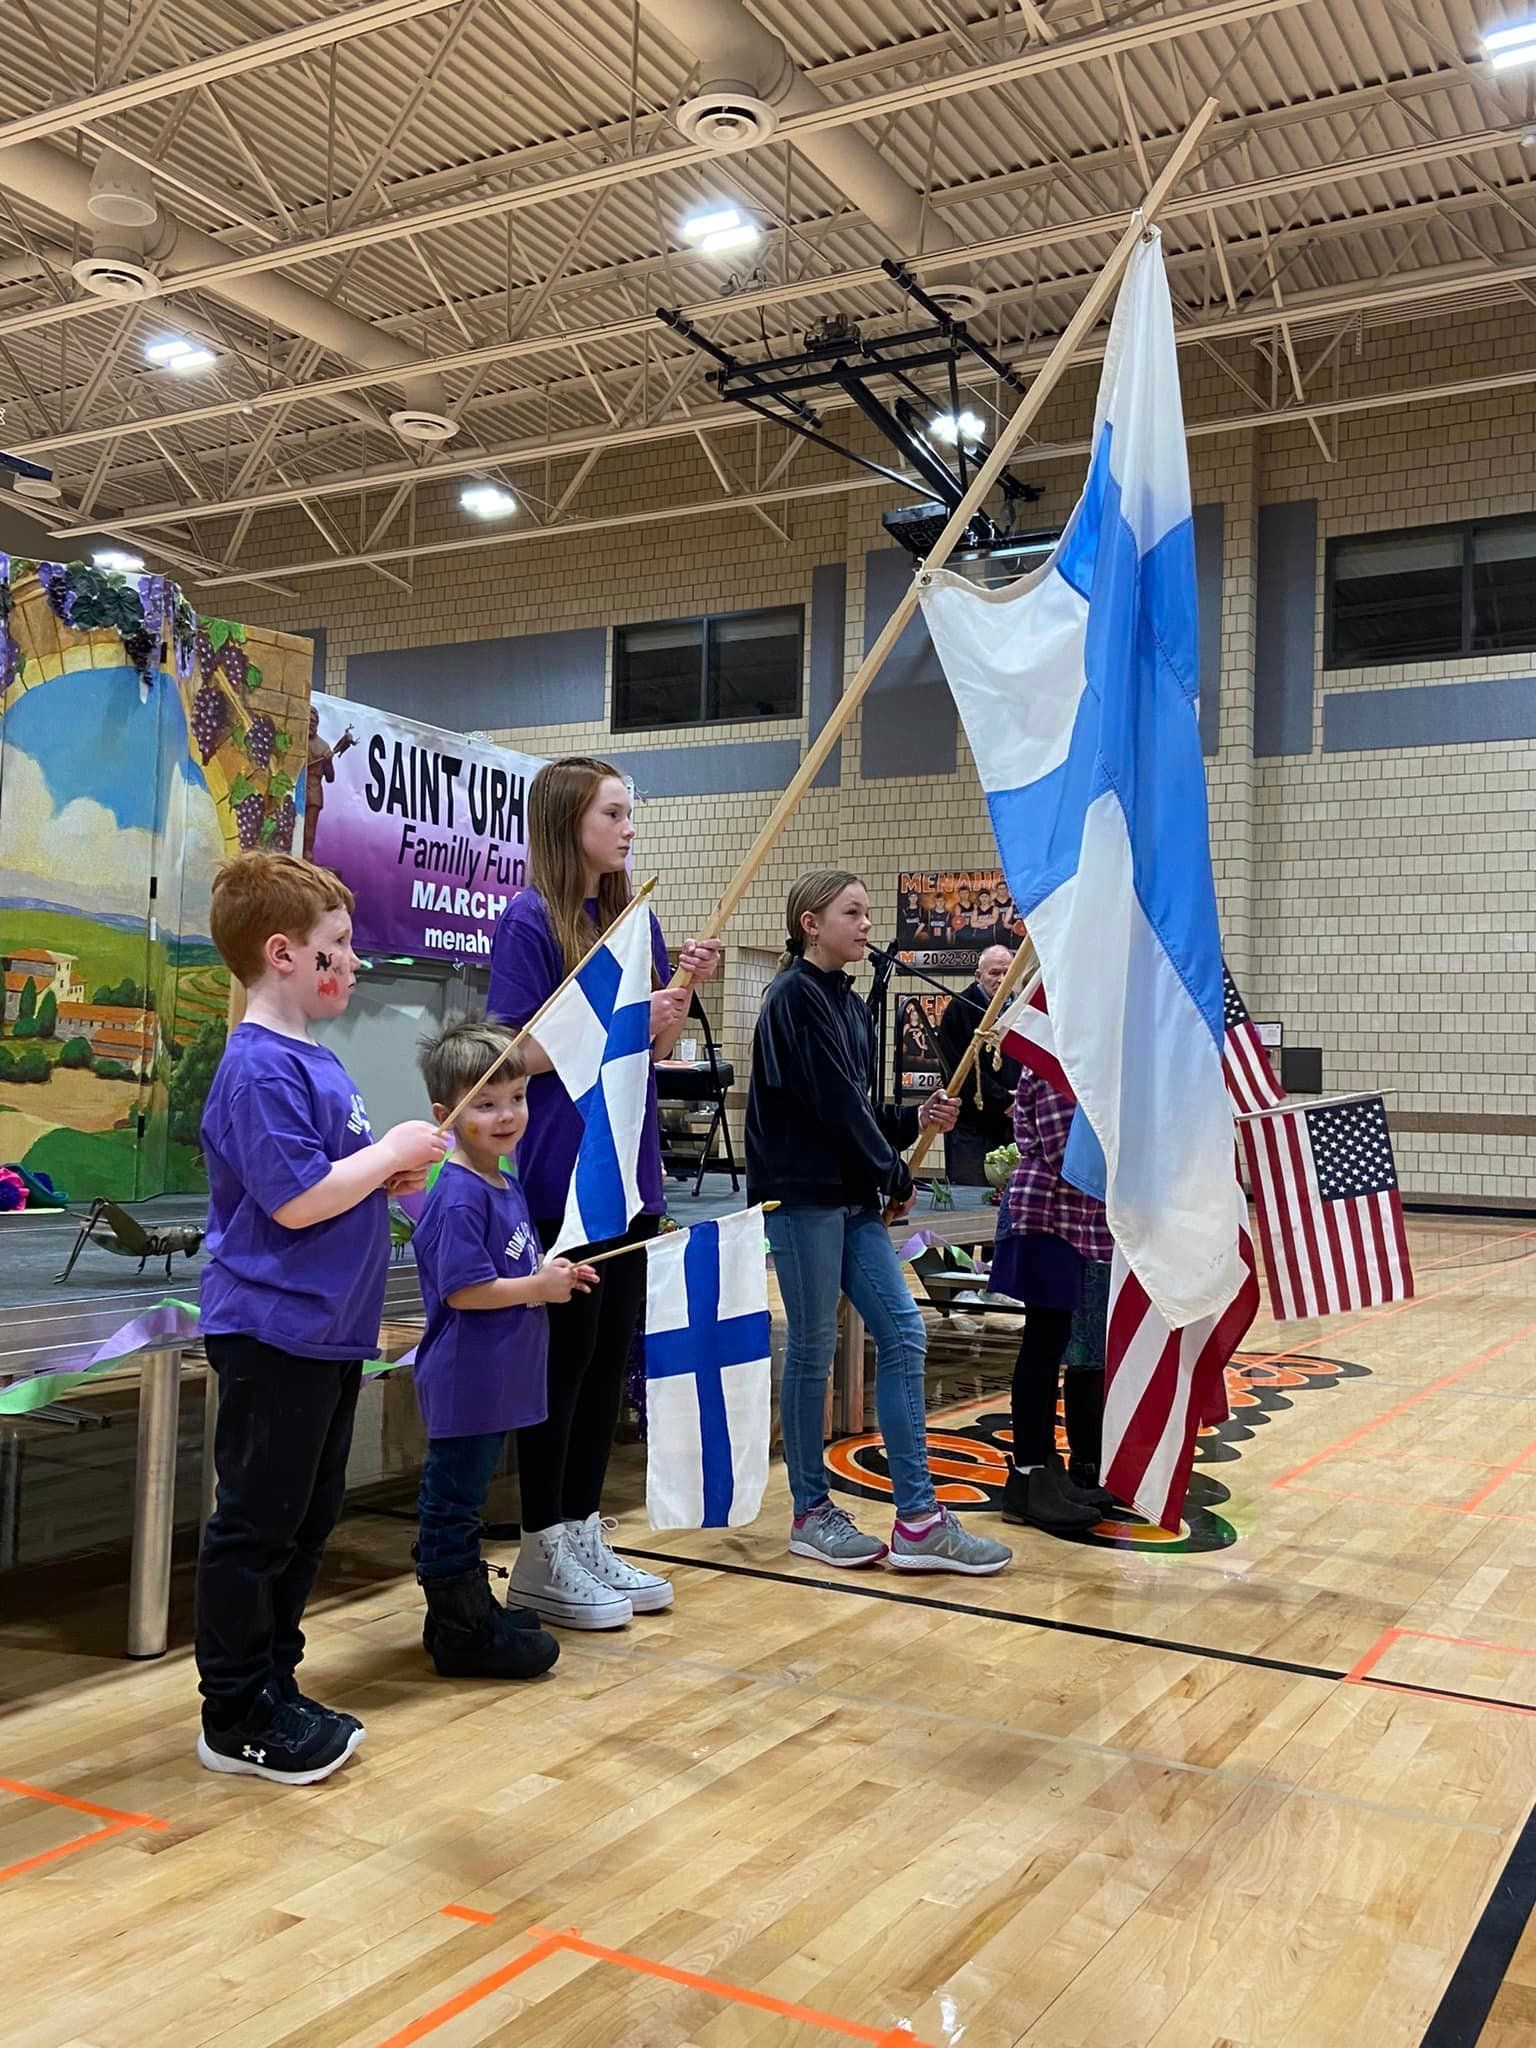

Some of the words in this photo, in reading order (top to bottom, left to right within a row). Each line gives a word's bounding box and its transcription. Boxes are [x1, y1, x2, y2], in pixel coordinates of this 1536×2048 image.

[365, 733, 463, 829] SAINT
[468, 763, 531, 845] URH
[397, 823, 482, 889] Familly
[484, 843, 526, 887] Fun
[411, 879, 507, 921] MARCH
[425, 926, 493, 955] menah
[922, 951, 980, 966] 2022-20
